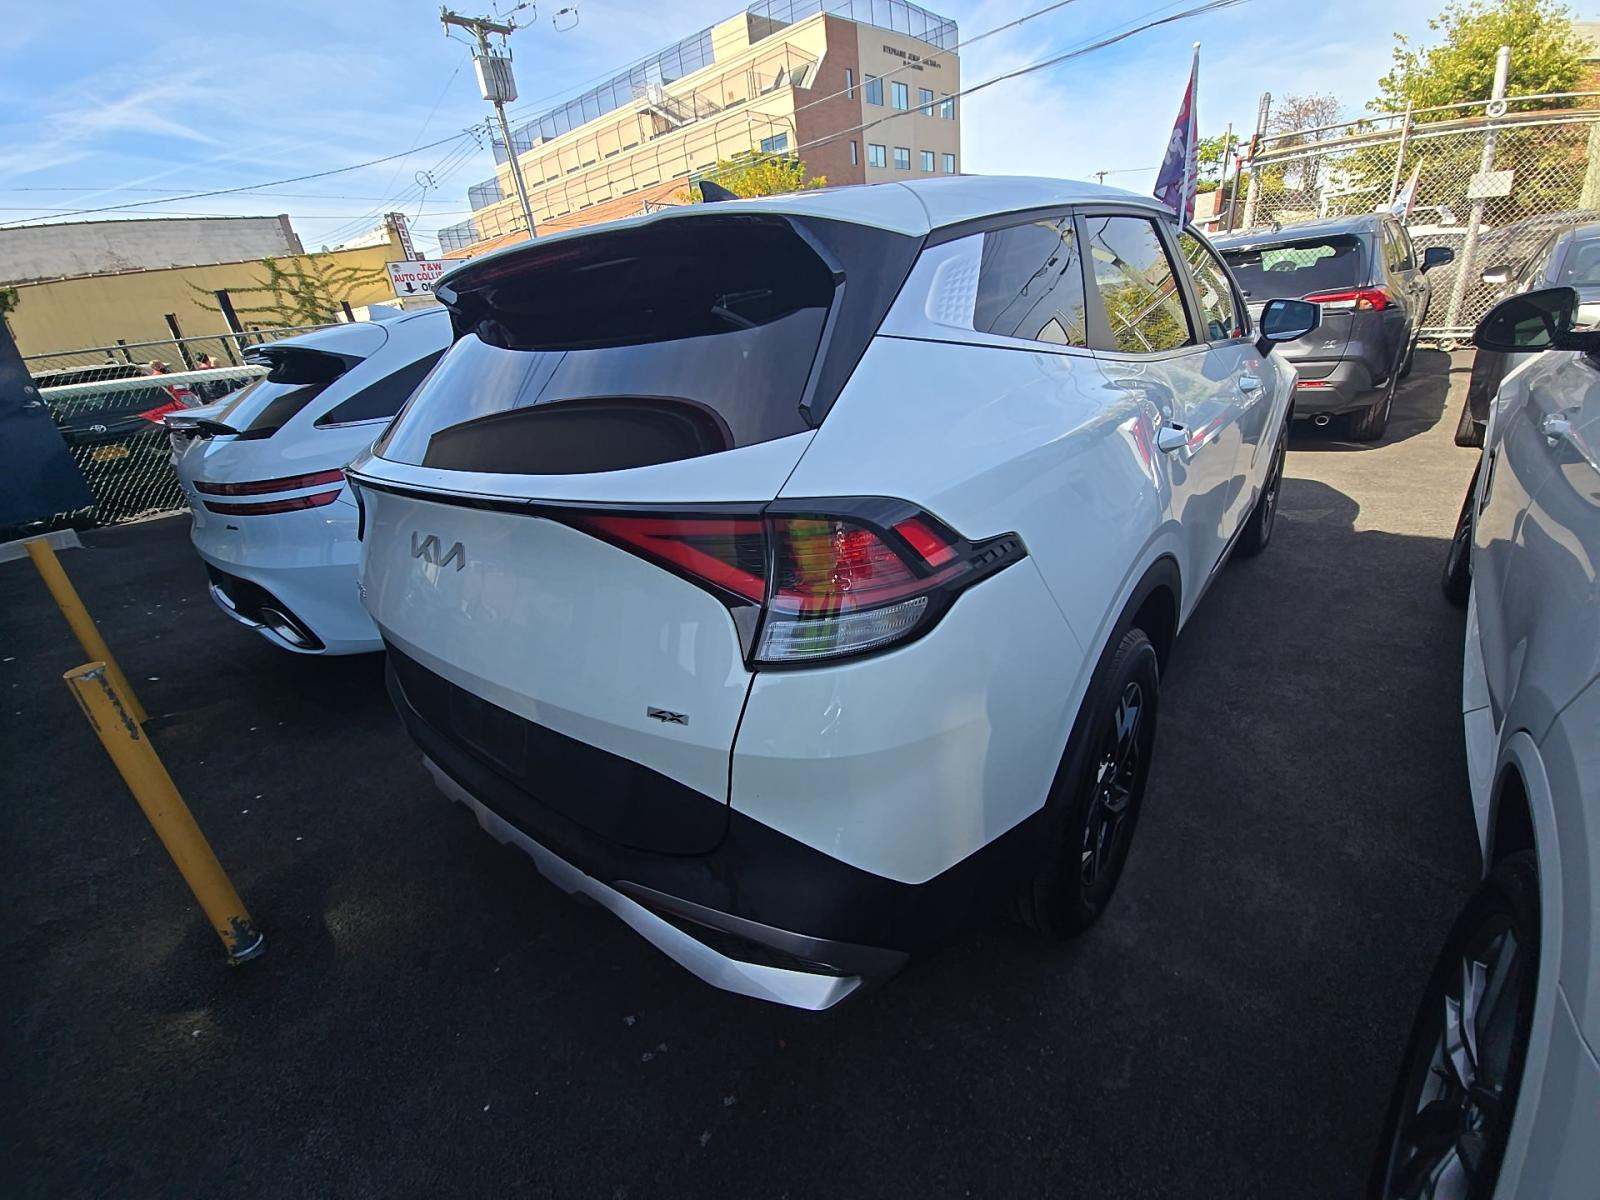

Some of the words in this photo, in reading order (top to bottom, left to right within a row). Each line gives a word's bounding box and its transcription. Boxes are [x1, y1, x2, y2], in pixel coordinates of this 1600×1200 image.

[419, 263, 442, 271] T&W
[394, 273, 415, 282] AUTO
[411, 530, 466, 572] KIA
